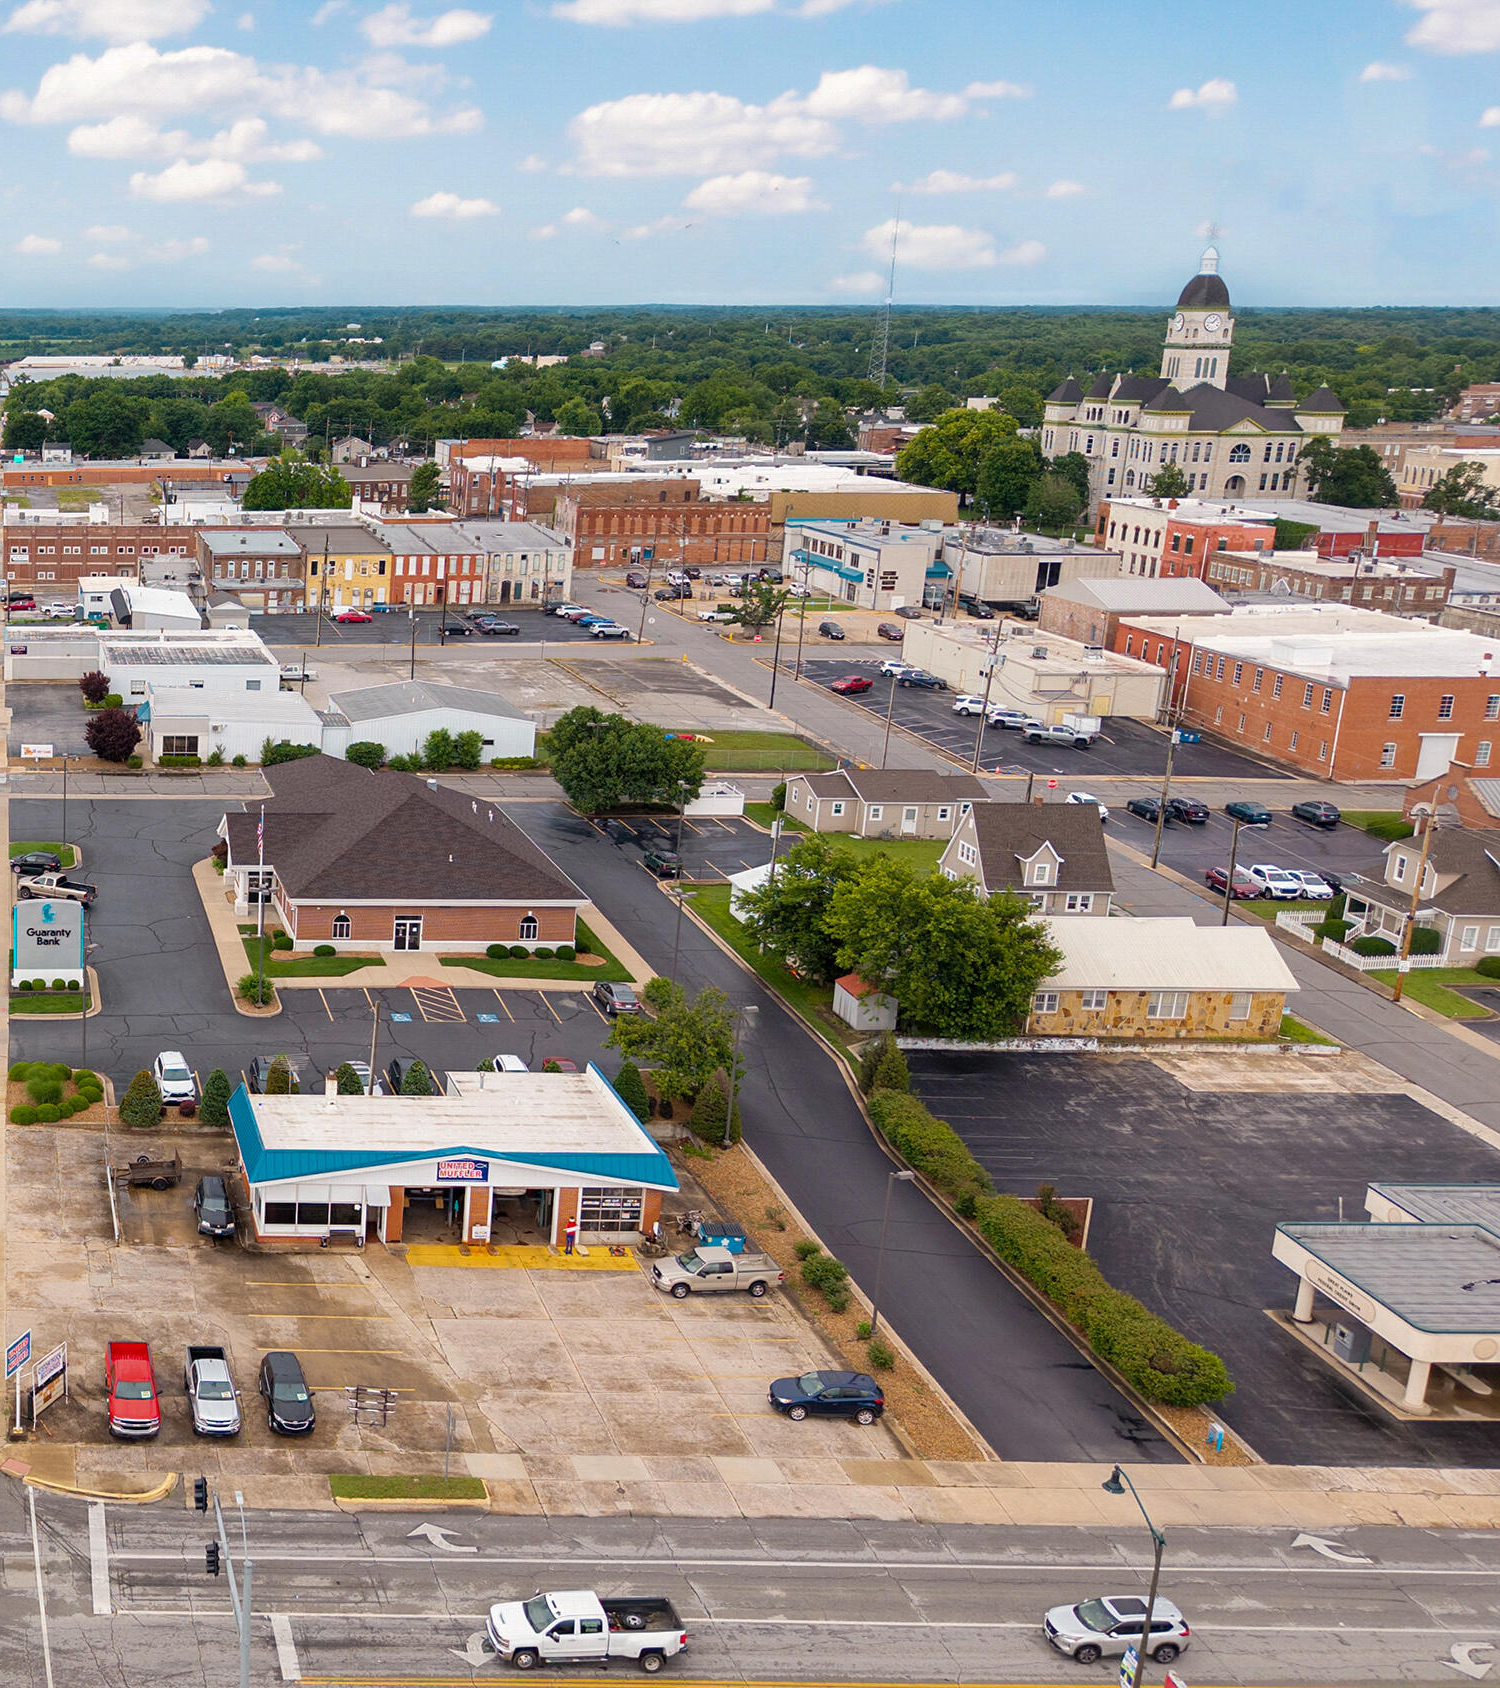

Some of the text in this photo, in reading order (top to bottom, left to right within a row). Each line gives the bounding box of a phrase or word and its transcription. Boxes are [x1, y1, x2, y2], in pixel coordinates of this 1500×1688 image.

[26, 928, 71, 938] Guaranty
[36, 937, 61, 946] Bank
[439, 1162, 475, 1170] UNITED
[439, 1170, 482, 1178] MUFFLER
